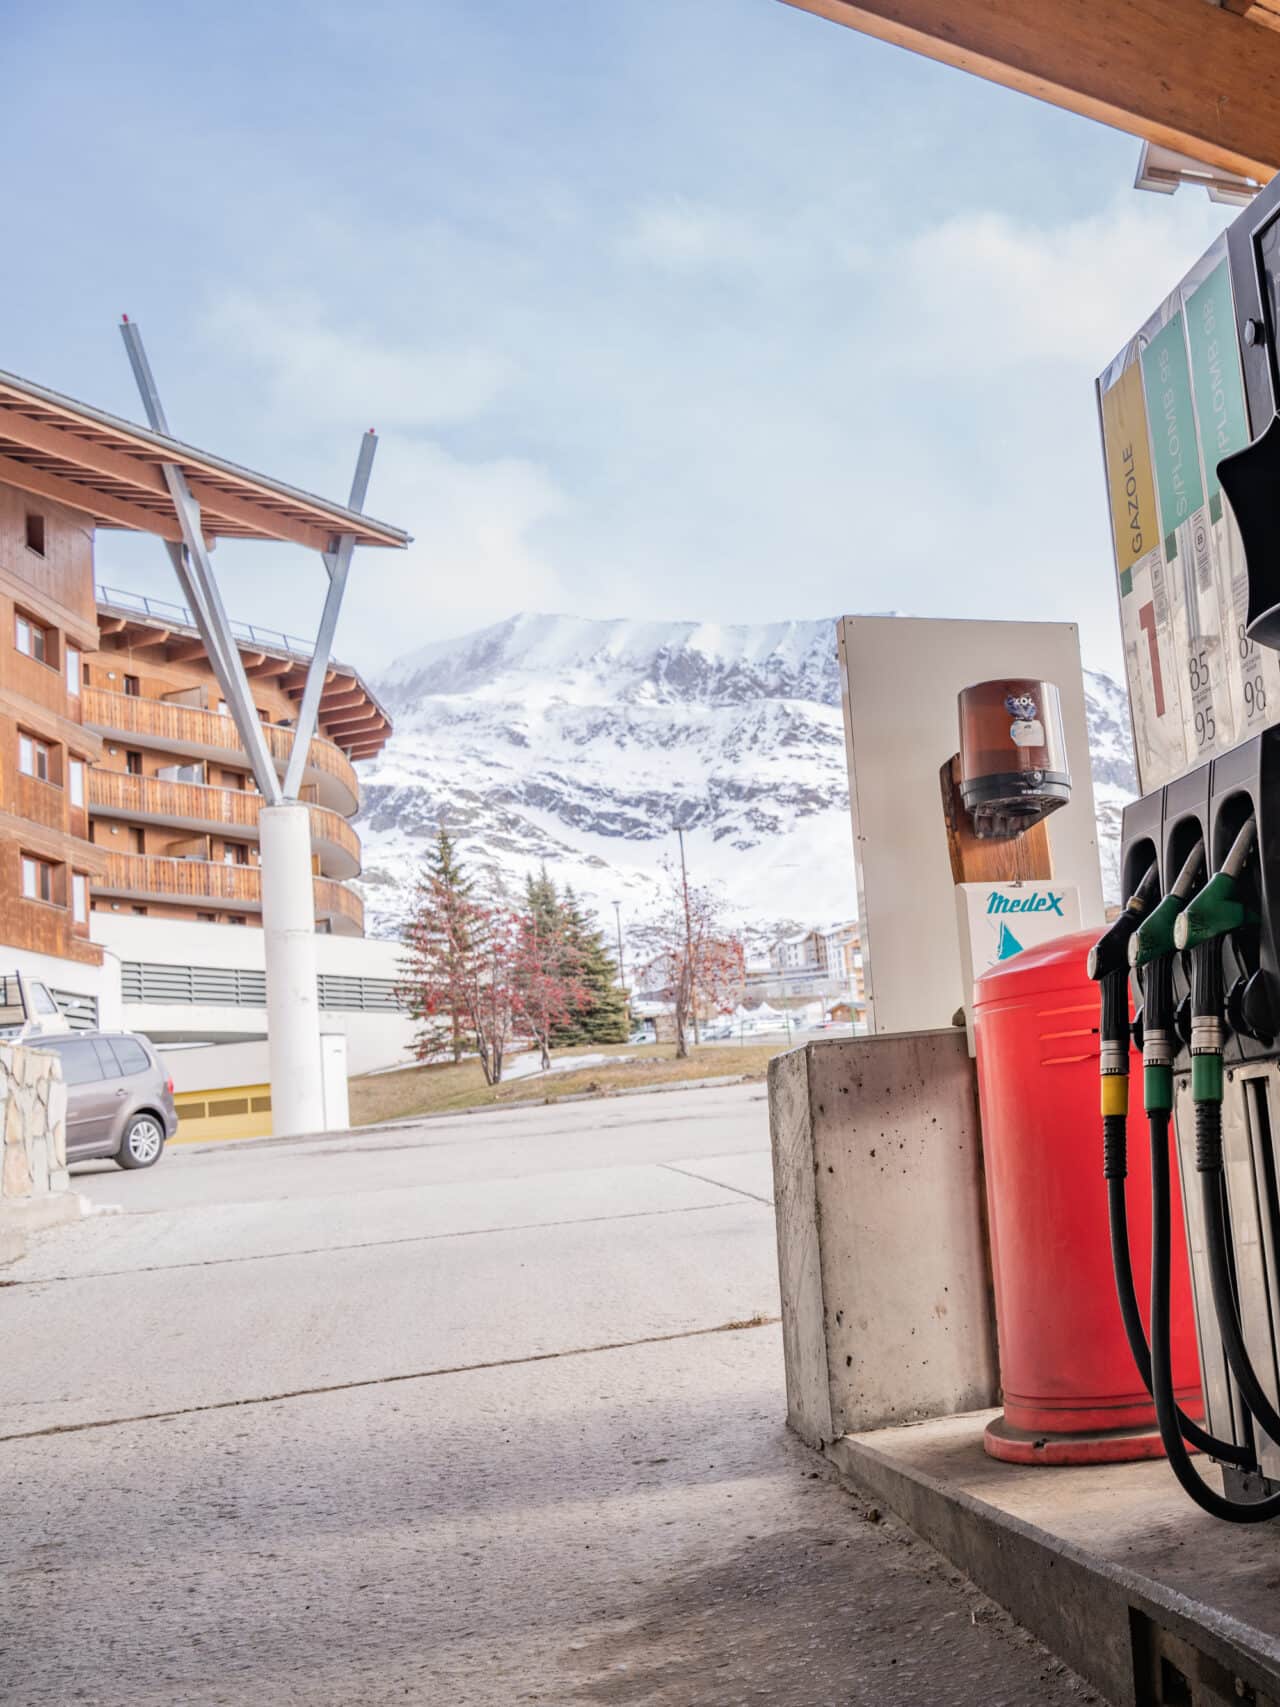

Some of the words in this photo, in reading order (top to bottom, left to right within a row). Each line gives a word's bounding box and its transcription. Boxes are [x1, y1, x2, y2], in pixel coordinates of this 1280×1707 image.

[1122, 440, 1143, 554] GAZOLE
[1138, 600, 1166, 718] 1
[1189, 650, 1210, 692] 85
[1244, 675, 1266, 718] 98
[1195, 705, 1216, 746] 95
